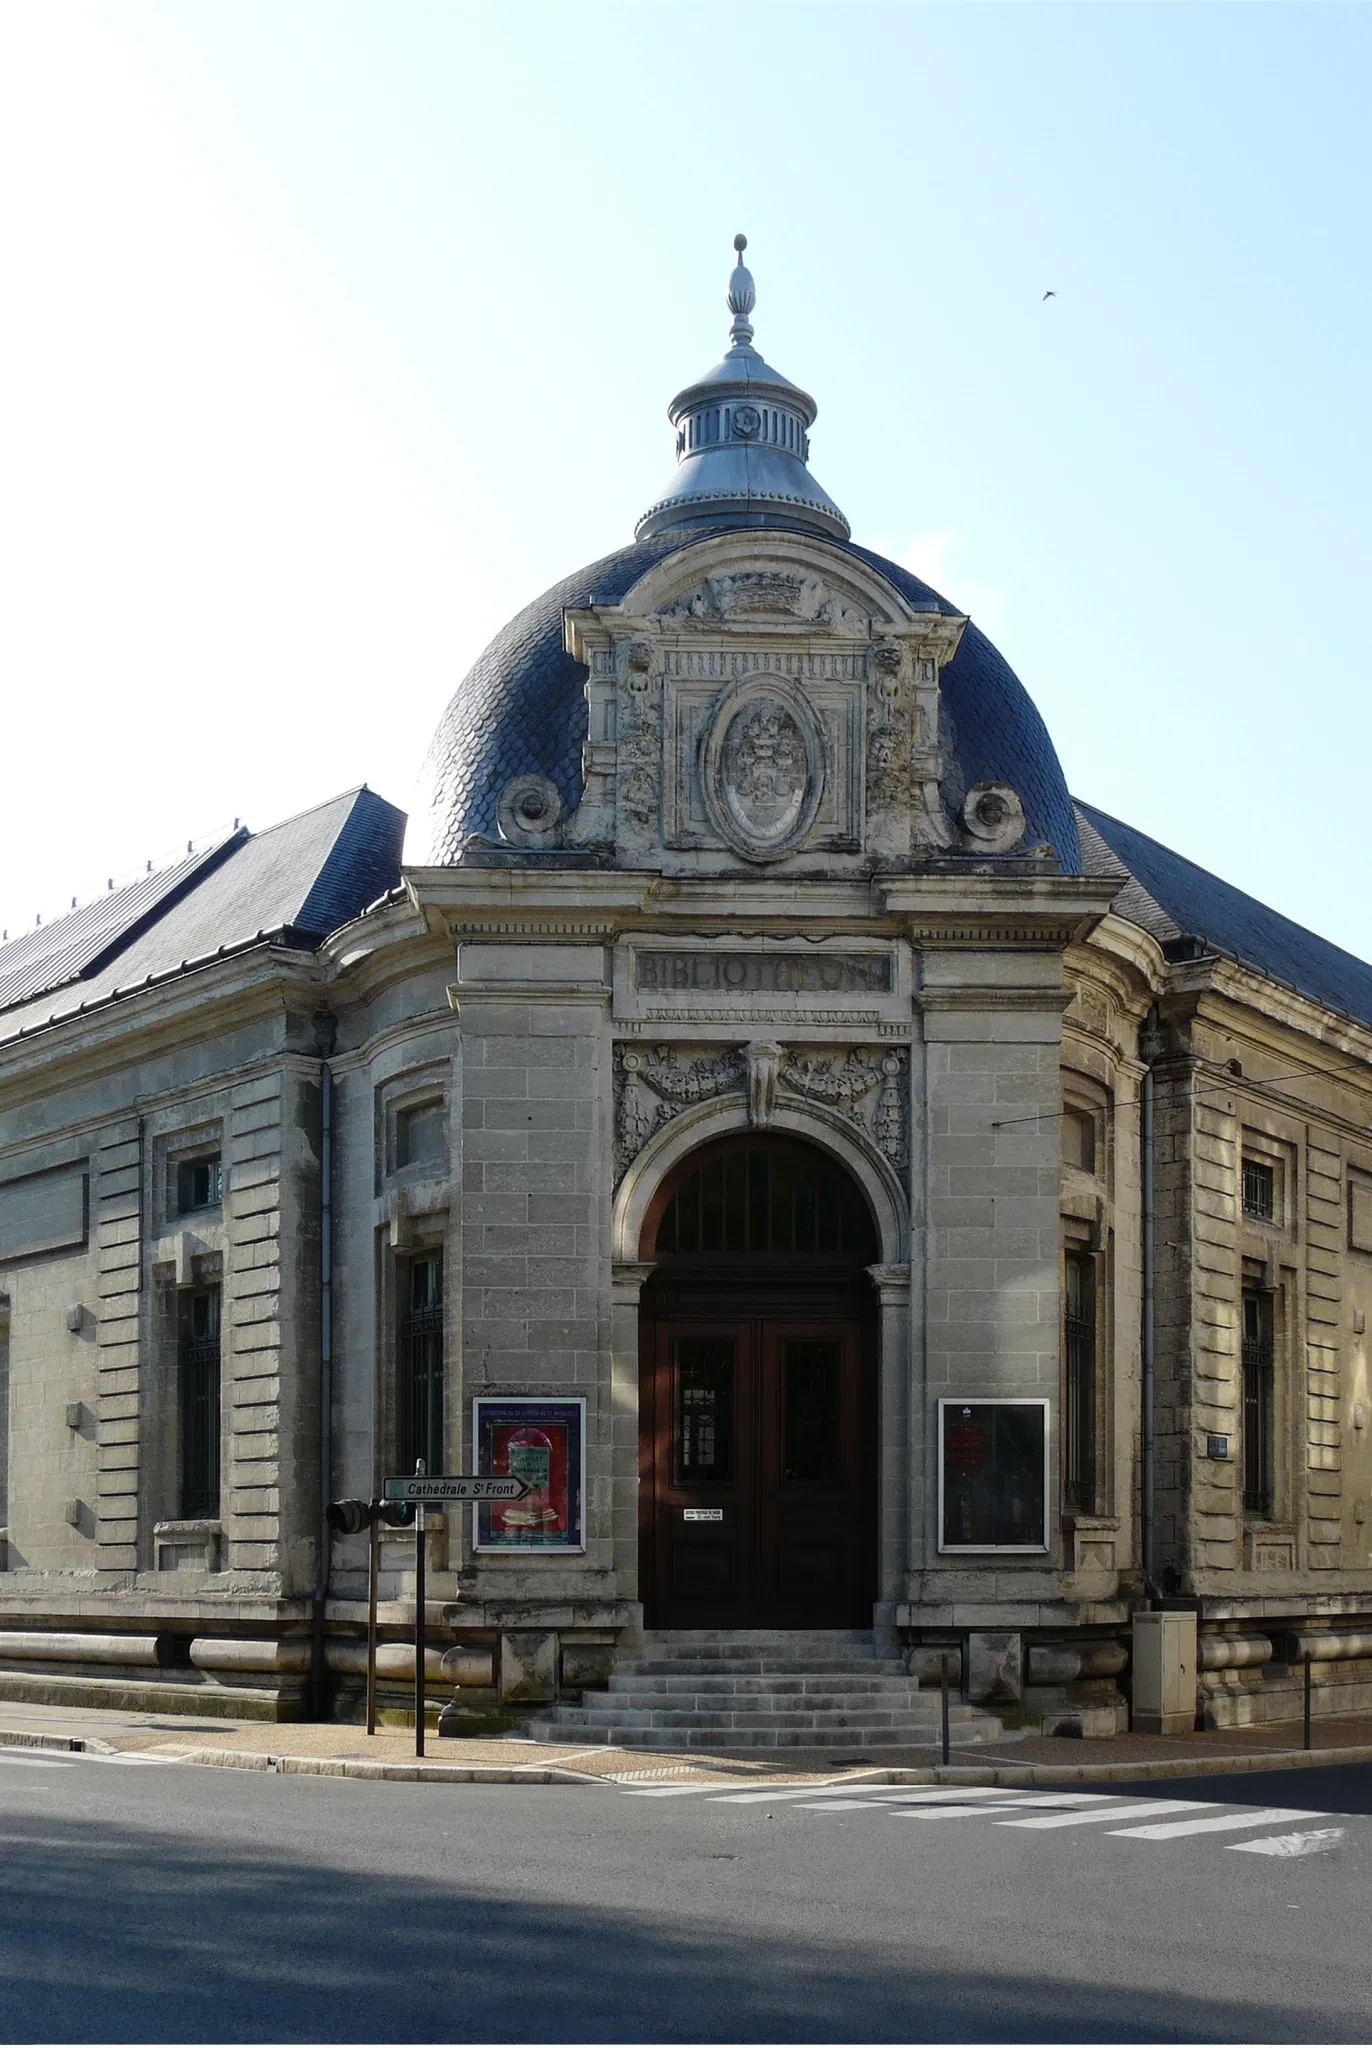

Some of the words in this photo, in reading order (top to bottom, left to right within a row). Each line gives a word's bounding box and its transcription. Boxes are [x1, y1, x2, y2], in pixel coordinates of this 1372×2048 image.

[408, 1482, 467, 1495] Cathédrale
[473, 1482, 484, 1495] St
[486, 1482, 515, 1495] Front
